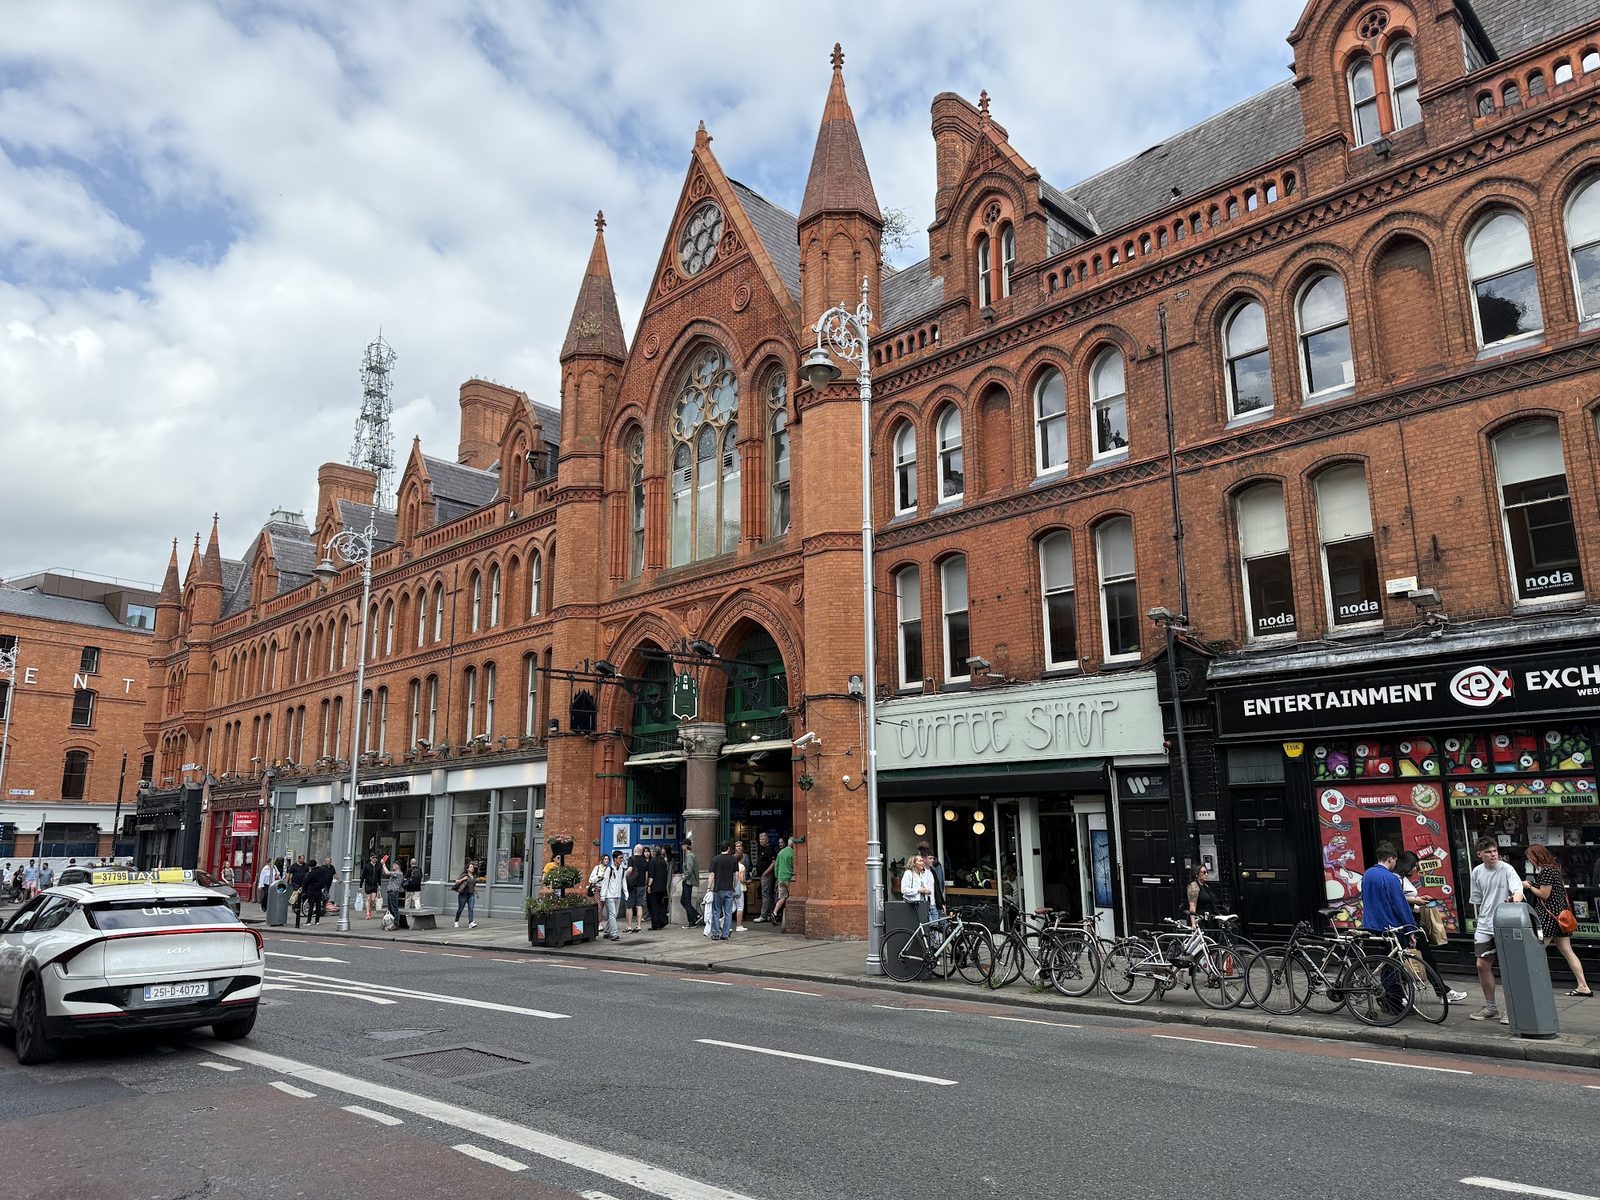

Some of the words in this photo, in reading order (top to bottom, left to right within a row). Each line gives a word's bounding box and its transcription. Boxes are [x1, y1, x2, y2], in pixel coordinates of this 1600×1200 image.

[1525, 570, 1574, 588] noda
[1339, 600, 1379, 615] noda
[1258, 613, 1294, 627] noda
[1525, 664, 1600, 691] EXCH
[1577, 687, 1600, 697] WEB
[1243, 681, 1437, 717] ENTERTAINMENT
[895, 708, 1011, 759] COFFEE
[1023, 699, 1119, 751] SHOP
[1455, 798, 1472, 806] FILM
[1473, 798, 1479, 806] &
[1480, 798, 1490, 806] TV
[1502, 796, 1547, 805] COMPUTING
[1560, 795, 1593, 804] GAMING
[1420, 861, 1439, 870] STUFF
[102, 872, 127, 881] 37799
[129, 871, 158, 880] TAXI
[1425, 876, 1445, 885] CASH
[141, 907, 192, 916] Uber
